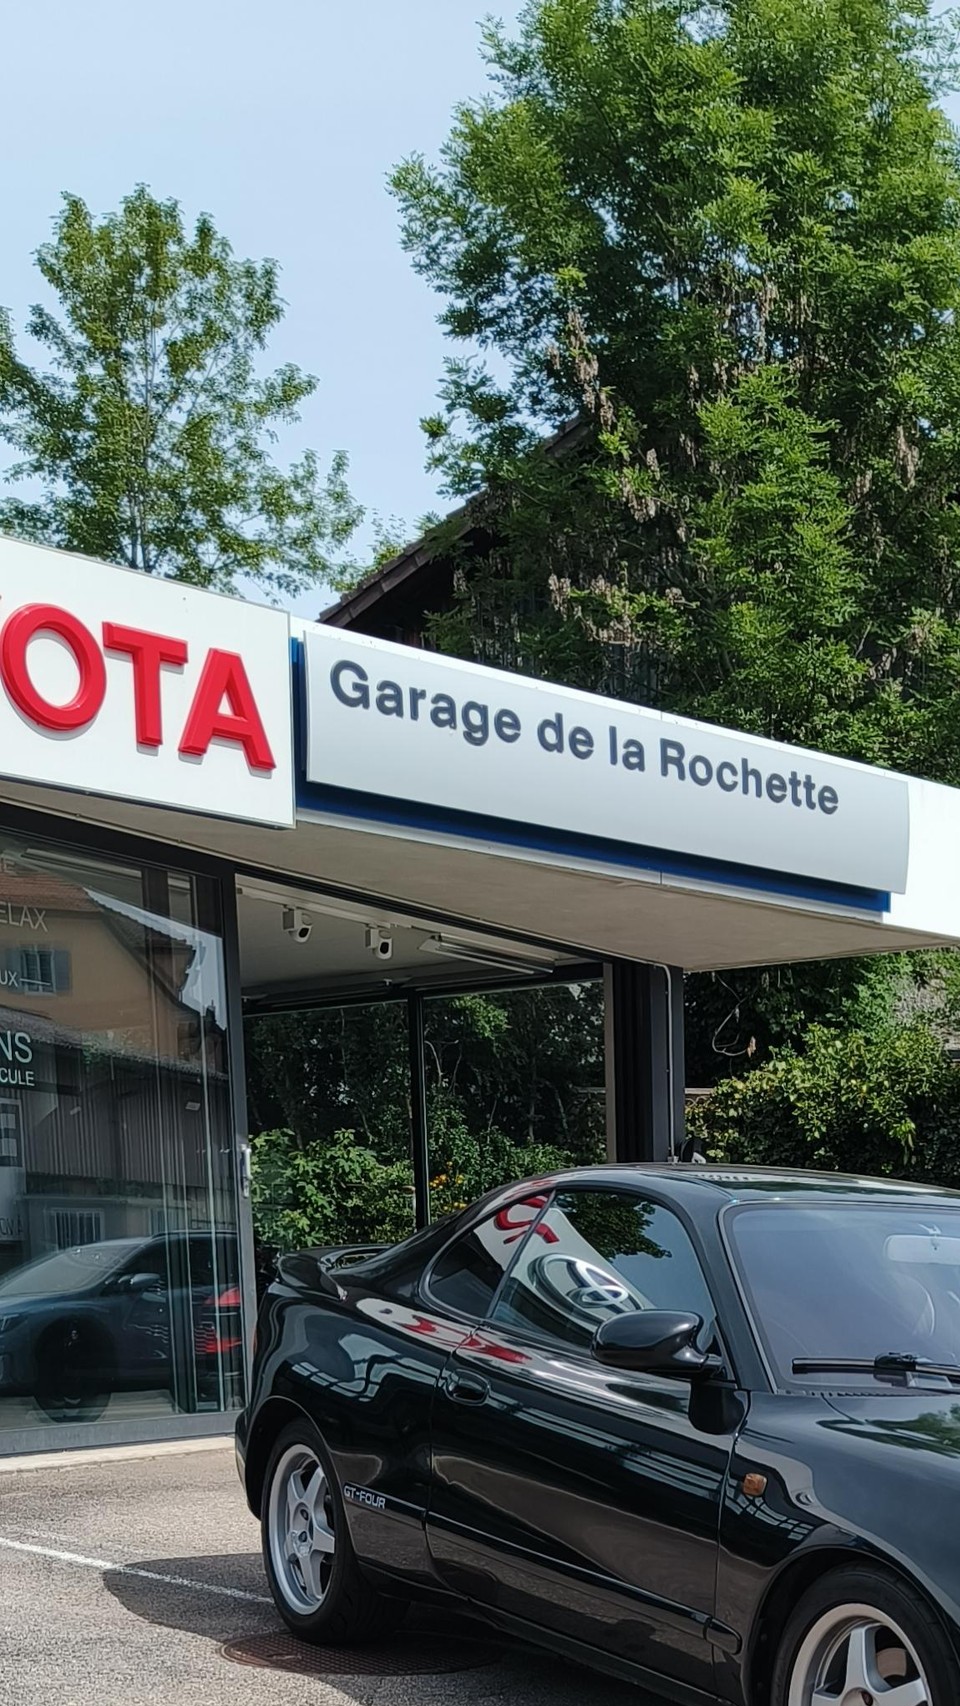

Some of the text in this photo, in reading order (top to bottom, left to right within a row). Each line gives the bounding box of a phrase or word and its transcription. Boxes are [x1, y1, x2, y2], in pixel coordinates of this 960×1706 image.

[0, 602, 277, 771] OTA
[329, 659, 840, 815] Garage de la Rochette
[0, 901, 48, 932] ELAX
[0, 969, 18, 988] UX
[0, 1030, 33, 1063] NS
[0, 1067, 35, 1087] CULE
[343, 1485, 386, 1509] GT-FOUR
